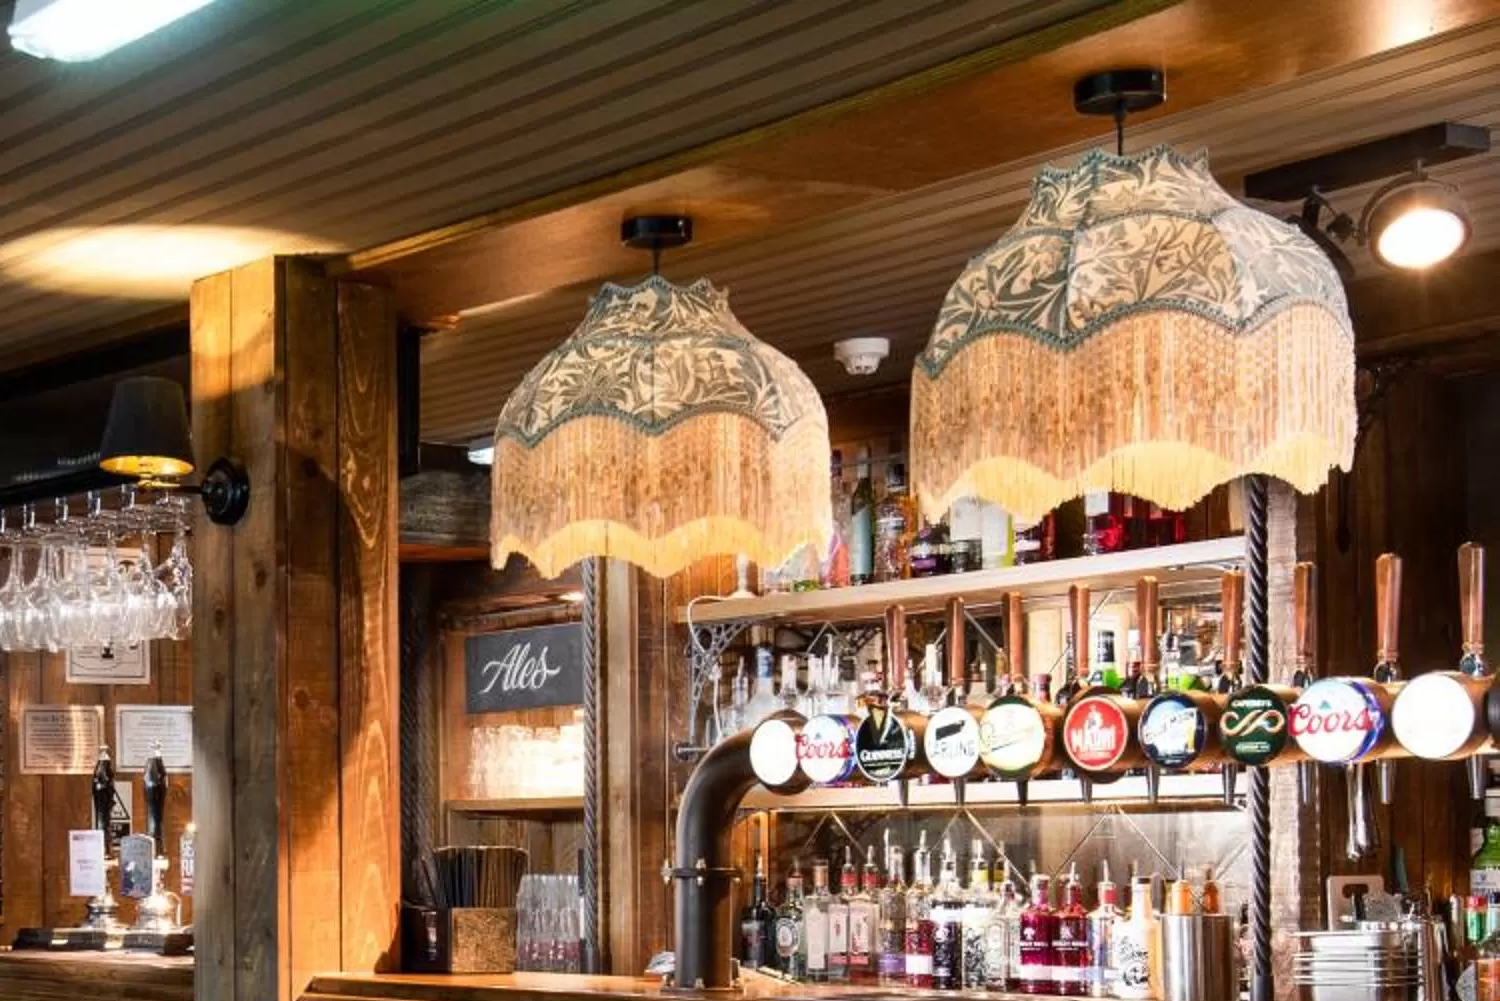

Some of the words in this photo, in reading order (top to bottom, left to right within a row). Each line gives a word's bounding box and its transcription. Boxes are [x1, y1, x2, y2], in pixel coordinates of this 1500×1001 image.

[479, 642, 561, 694] Ales
[1288, 703, 1373, 737] Coors
[796, 734, 850, 759] Coors
